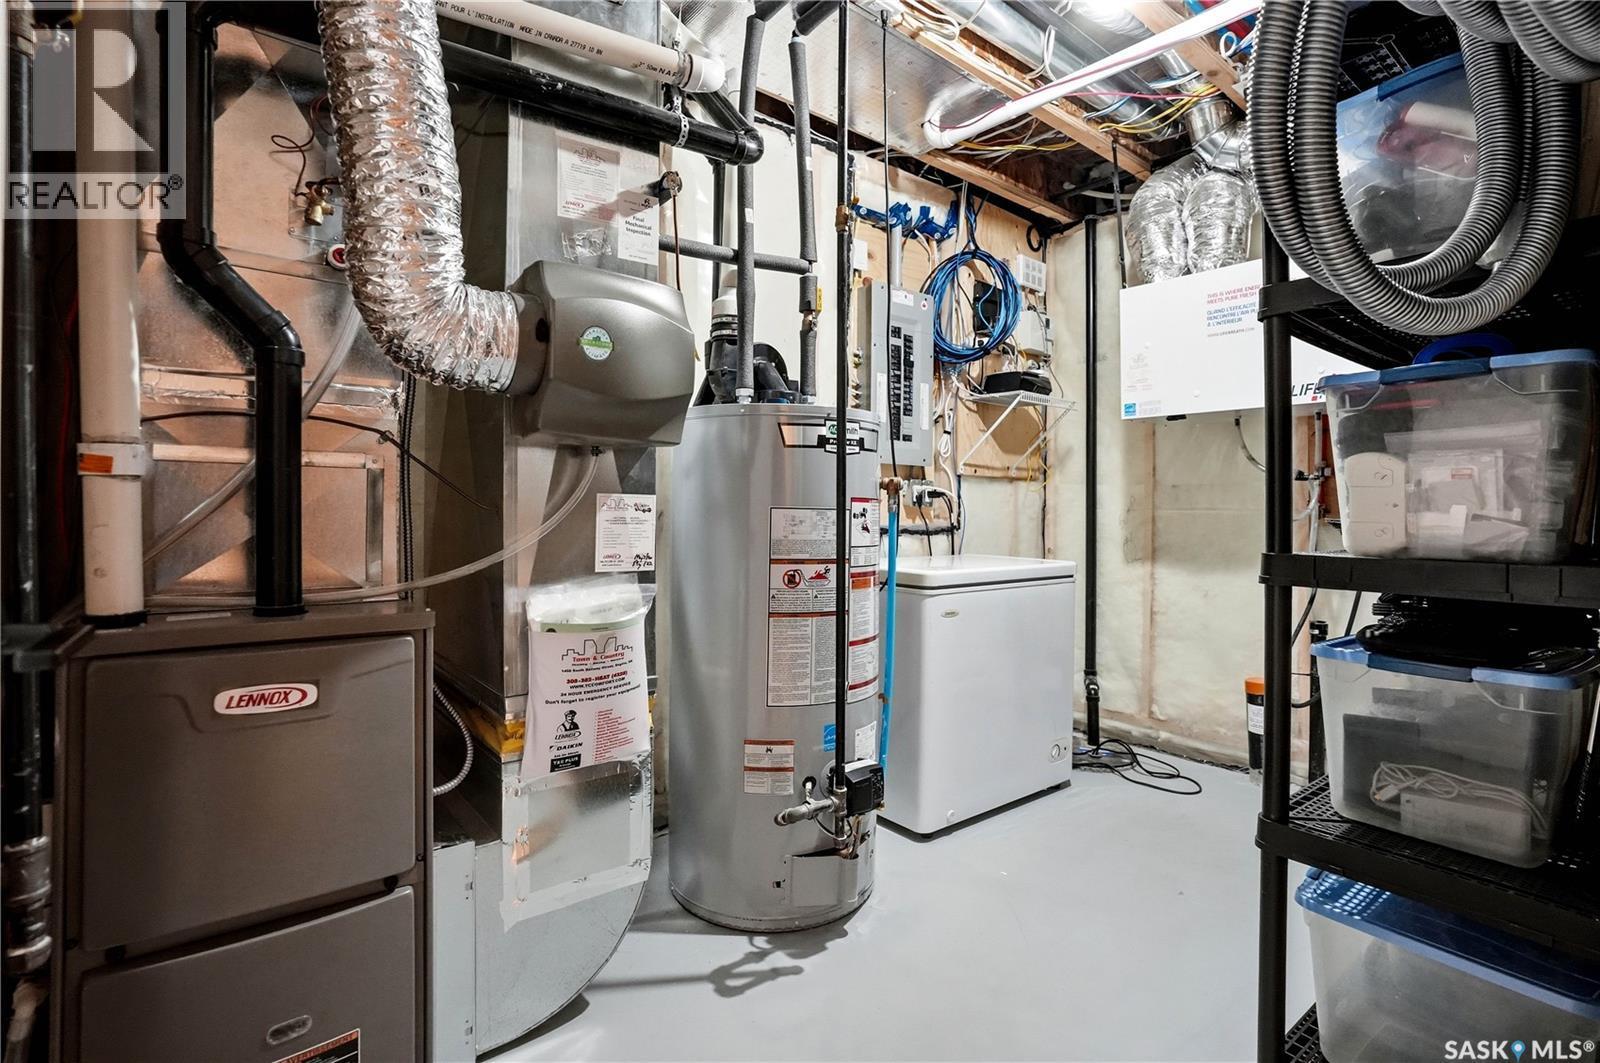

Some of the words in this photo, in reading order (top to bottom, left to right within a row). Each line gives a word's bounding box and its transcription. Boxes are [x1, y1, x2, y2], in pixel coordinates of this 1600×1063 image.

[451, 4, 465, 13] POUR
[519, 25, 534, 35] MADE
[544, 32, 564, 44] CANADA
[625, 220, 652, 231] Mechanical
[625, 227, 652, 236] Inspection
[1292, 383, 1325, 397] LIFE
[572, 655, 590, 663] Town
[600, 652, 625, 661] Country
[583, 687, 612, 695] EMERGENCY
[224, 690, 293, 710] LENNOX
[557, 742, 583, 751] DAIKIN
